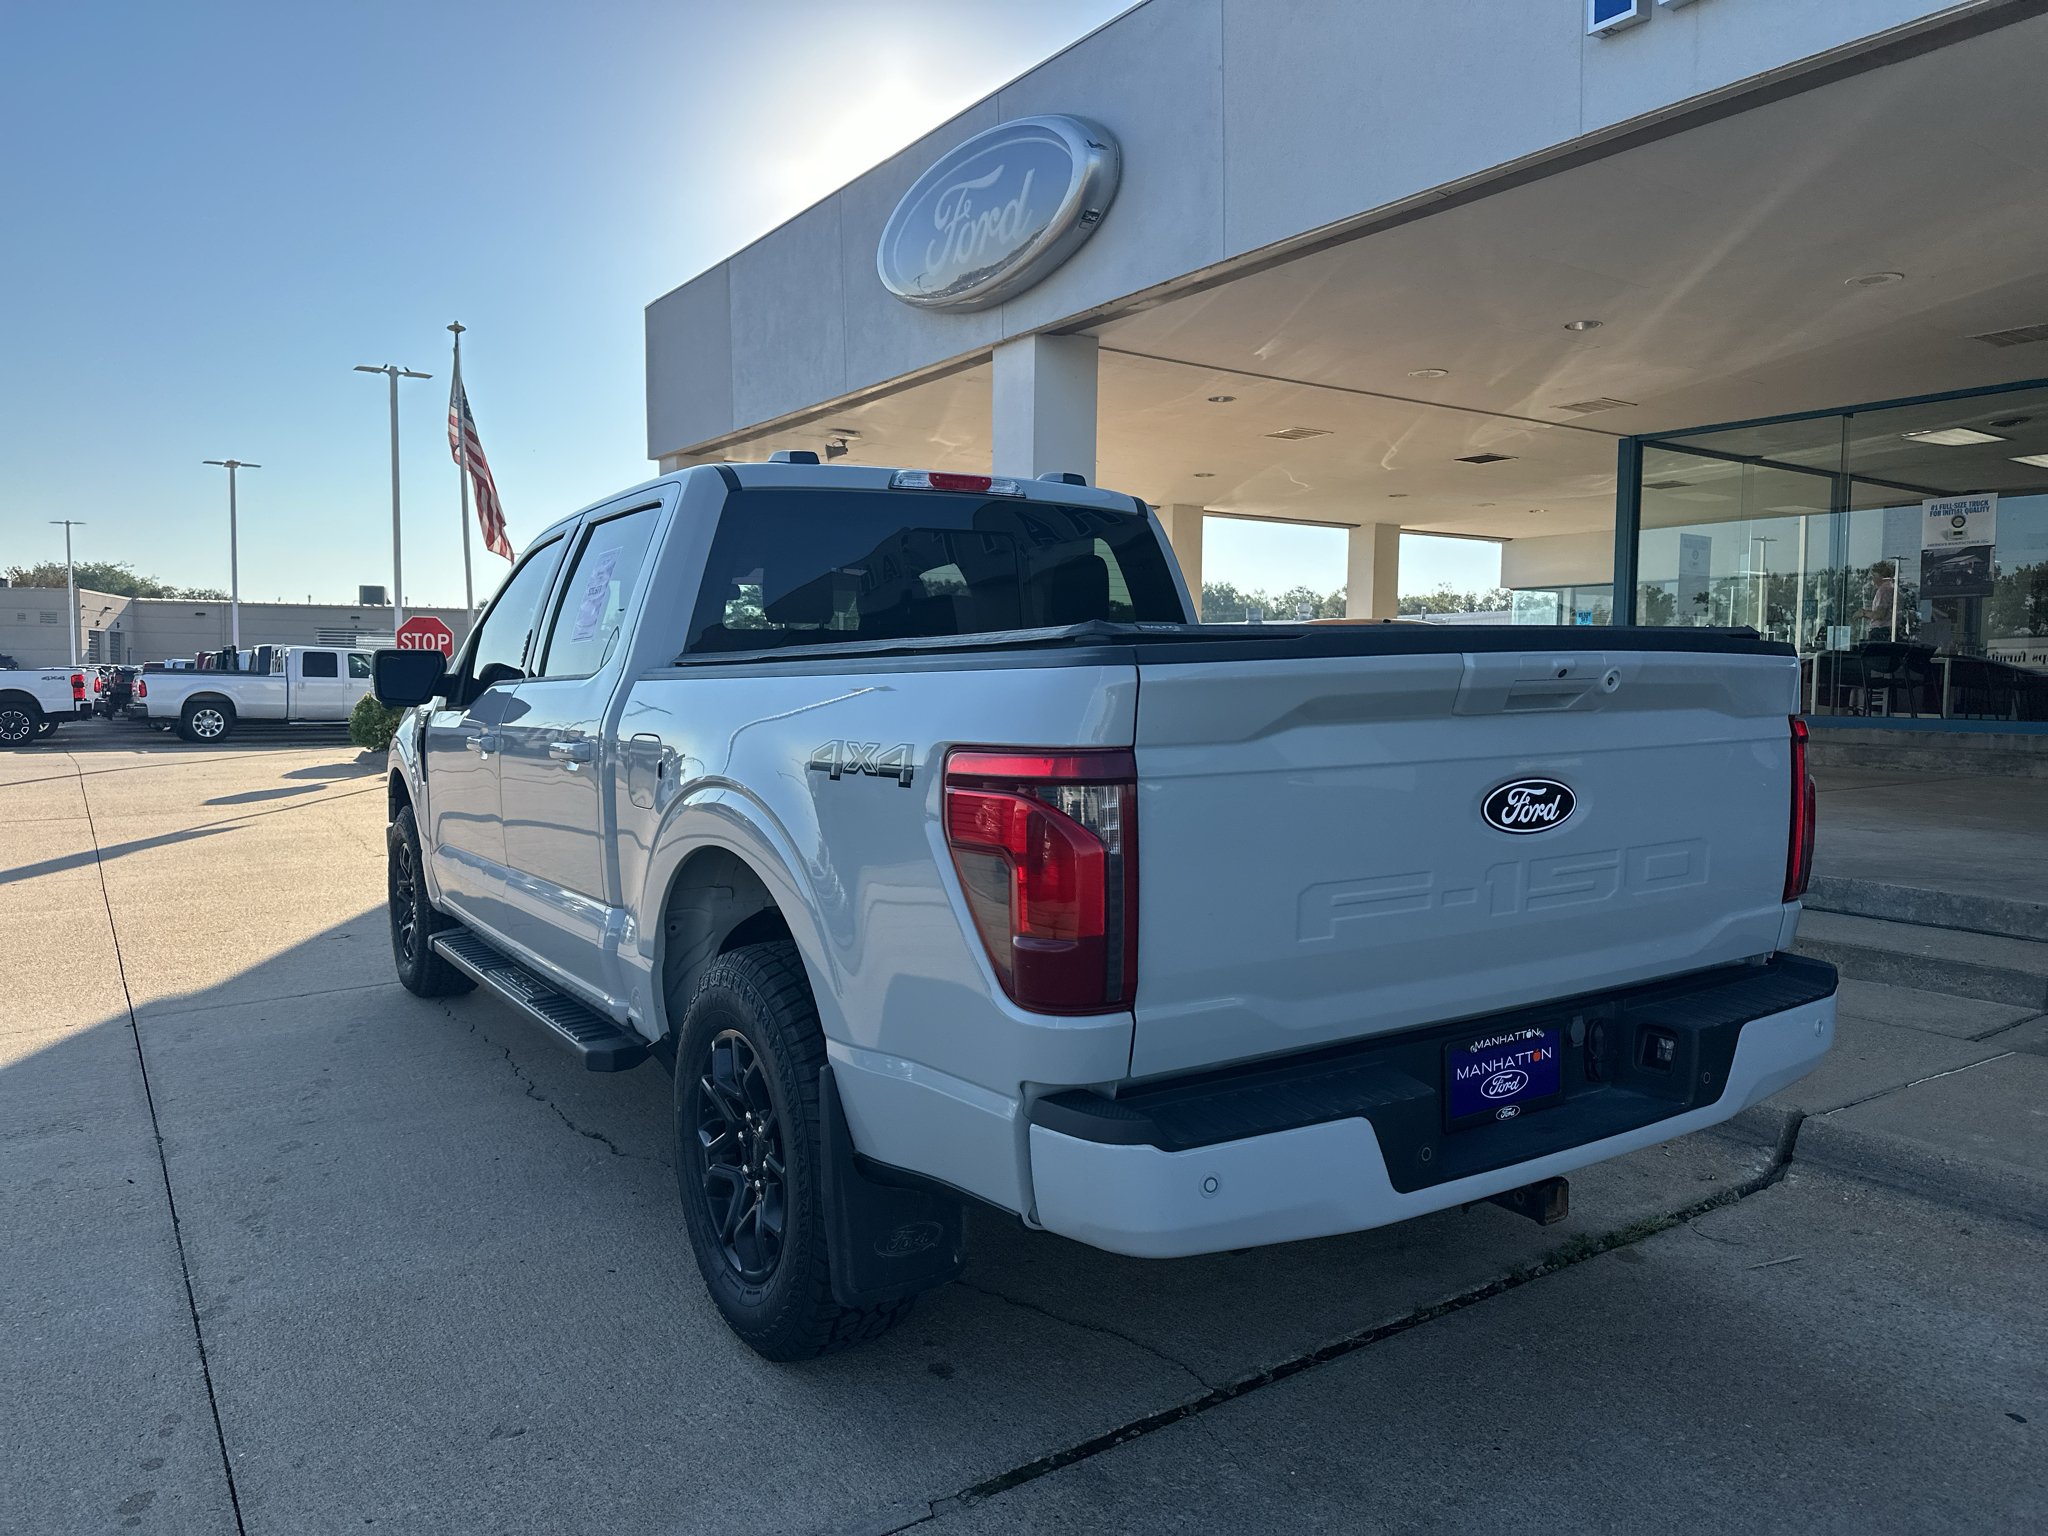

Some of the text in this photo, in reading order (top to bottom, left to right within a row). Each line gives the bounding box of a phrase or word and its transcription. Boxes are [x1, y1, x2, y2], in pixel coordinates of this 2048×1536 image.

[925, 164, 1035, 276] Ford
[1965, 505, 1990, 515] QUALITY
[1969, 500, 1989, 508] TRUCK
[400, 632, 450, 650] STOP
[1501, 787, 1561, 825] Ford
[1297, 837, 1710, 943] F-150
[1489, 1073, 1521, 1095] Ford
[1500, 1107, 1516, 1119] Ford
